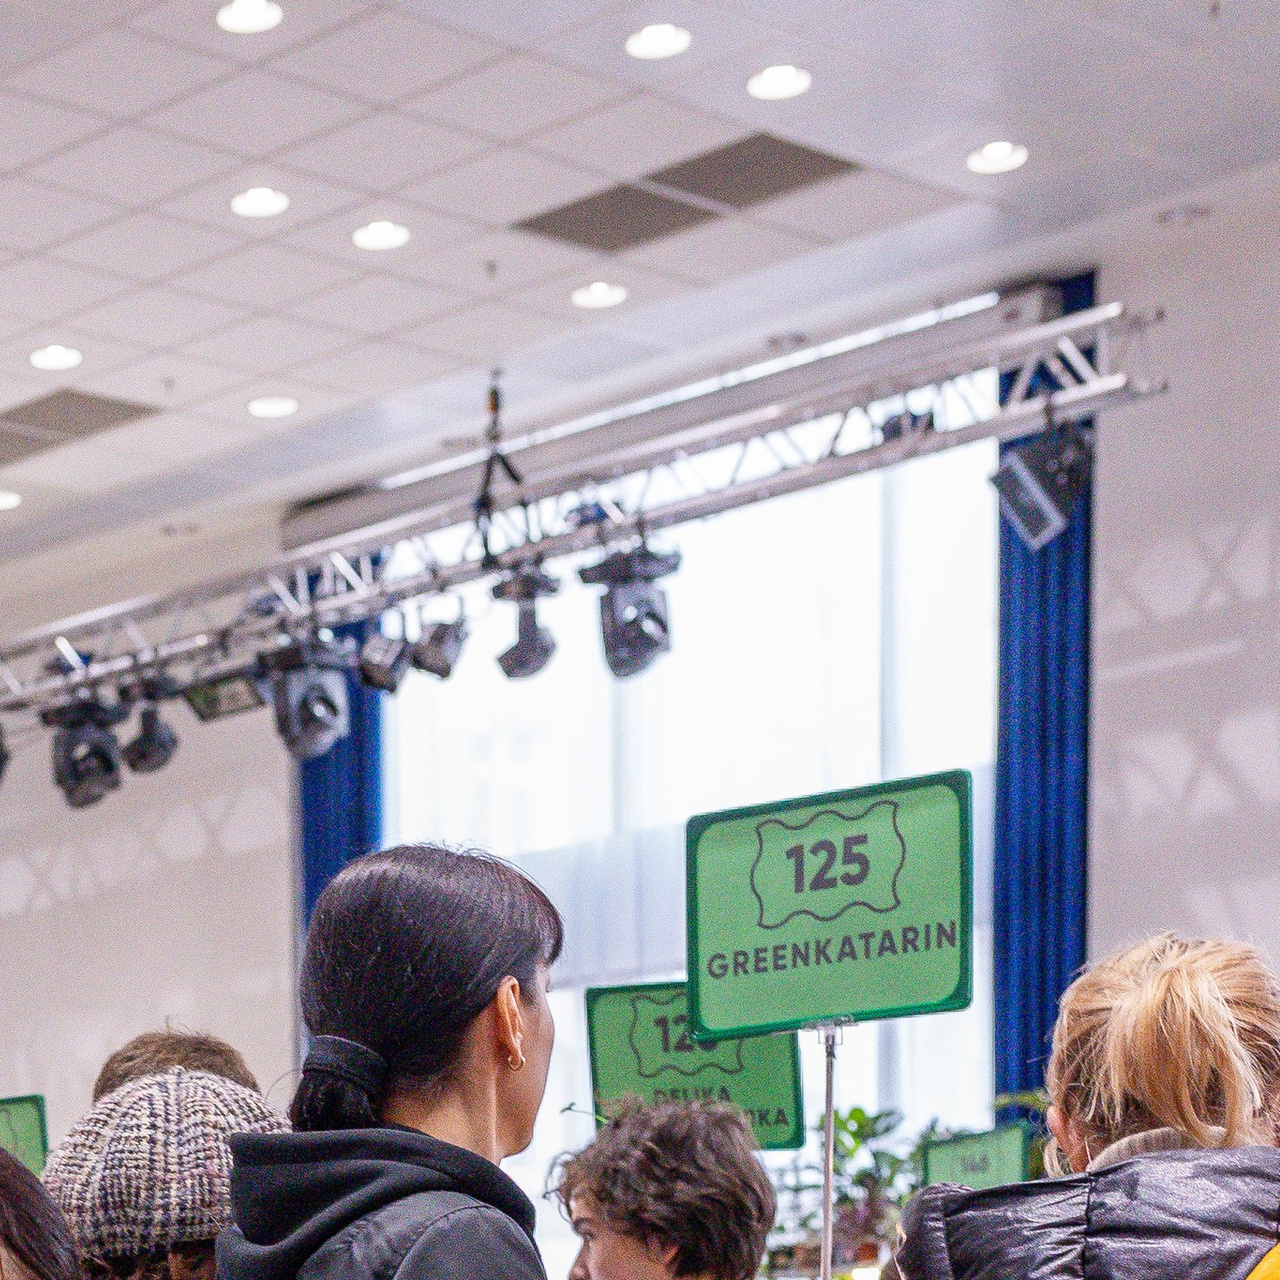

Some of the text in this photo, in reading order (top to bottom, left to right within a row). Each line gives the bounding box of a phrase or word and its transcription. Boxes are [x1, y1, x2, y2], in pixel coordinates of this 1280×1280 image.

[785, 833, 870, 893] 125
[707, 920, 957, 979] GREENKATARIN
[654, 1013, 718, 1053] 12
